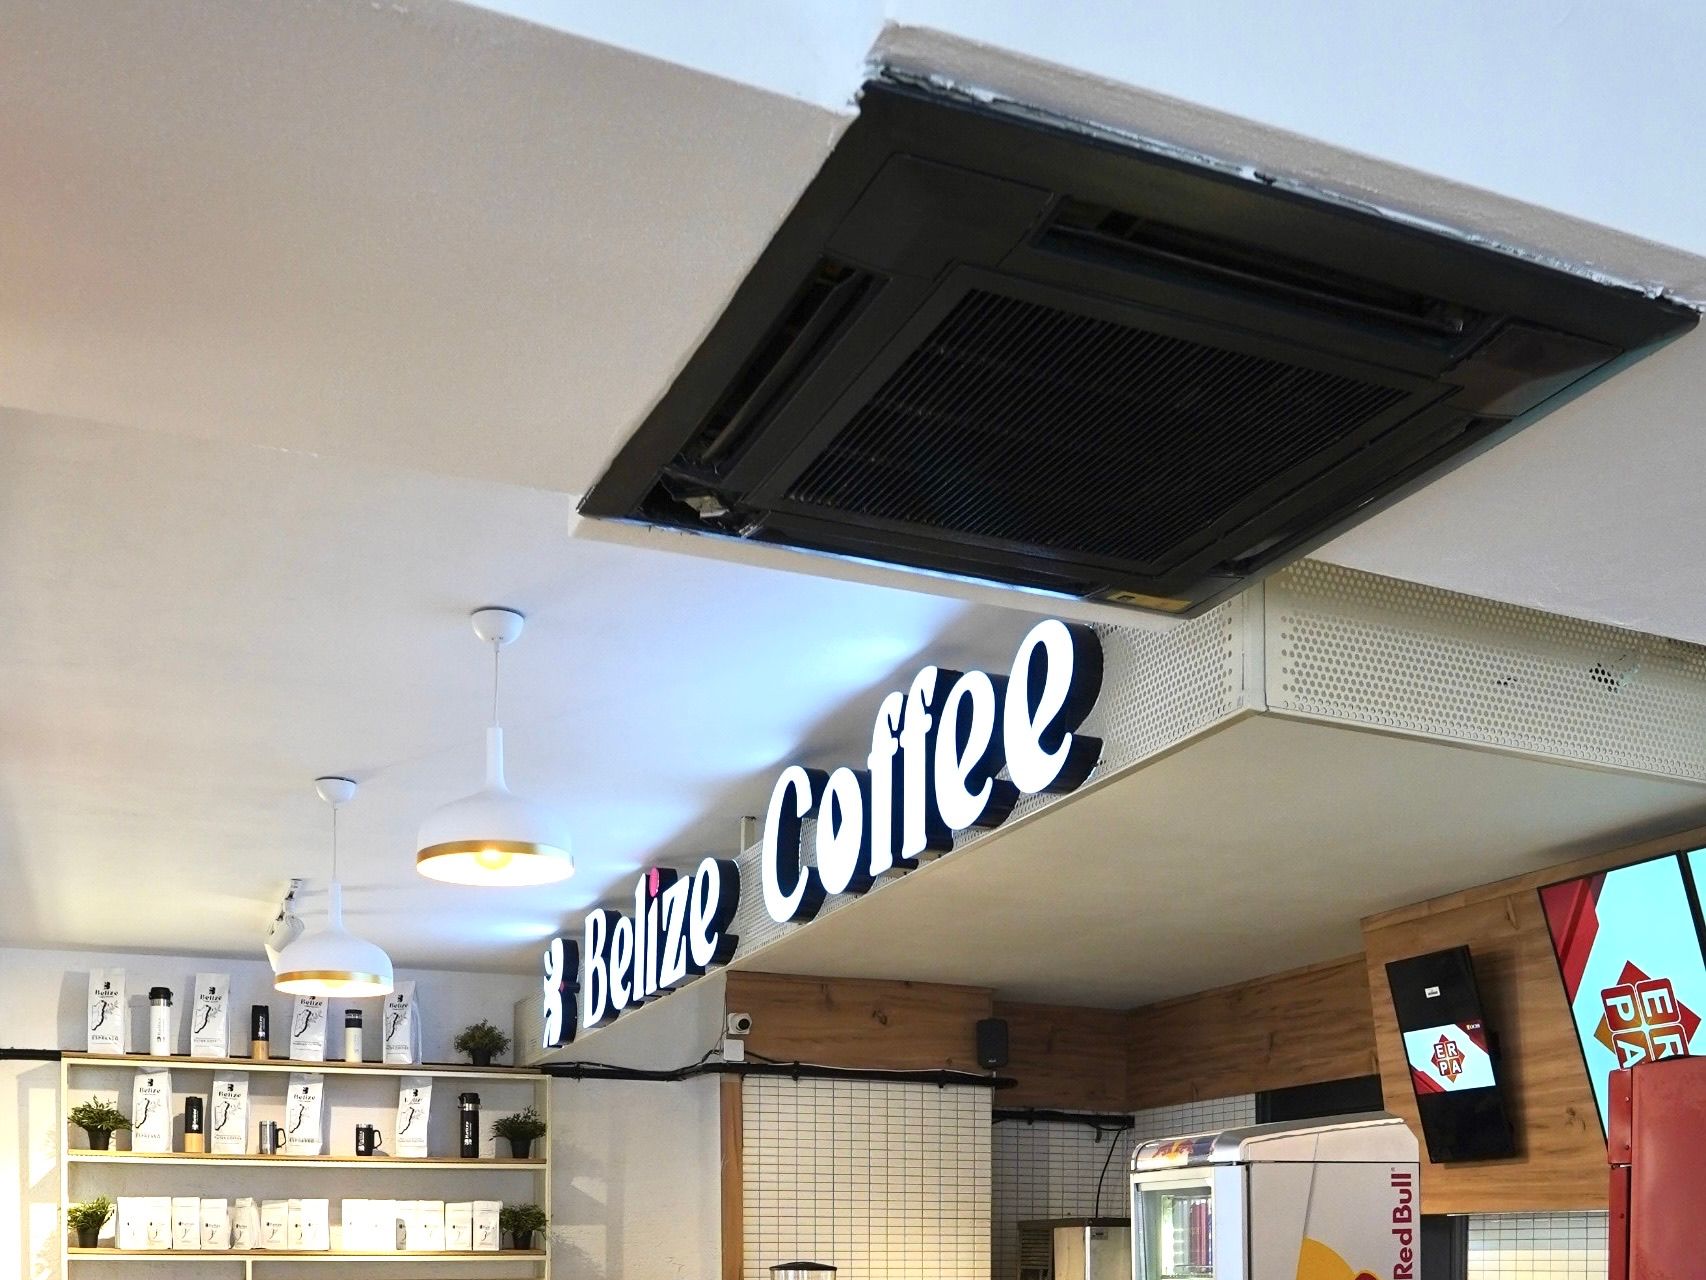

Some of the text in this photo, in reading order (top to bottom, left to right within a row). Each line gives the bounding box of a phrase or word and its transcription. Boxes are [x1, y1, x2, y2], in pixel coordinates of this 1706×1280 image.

[583, 618, 1075, 1029] Belize Coffee
[1390, 1173, 1413, 1280] Red Bull
